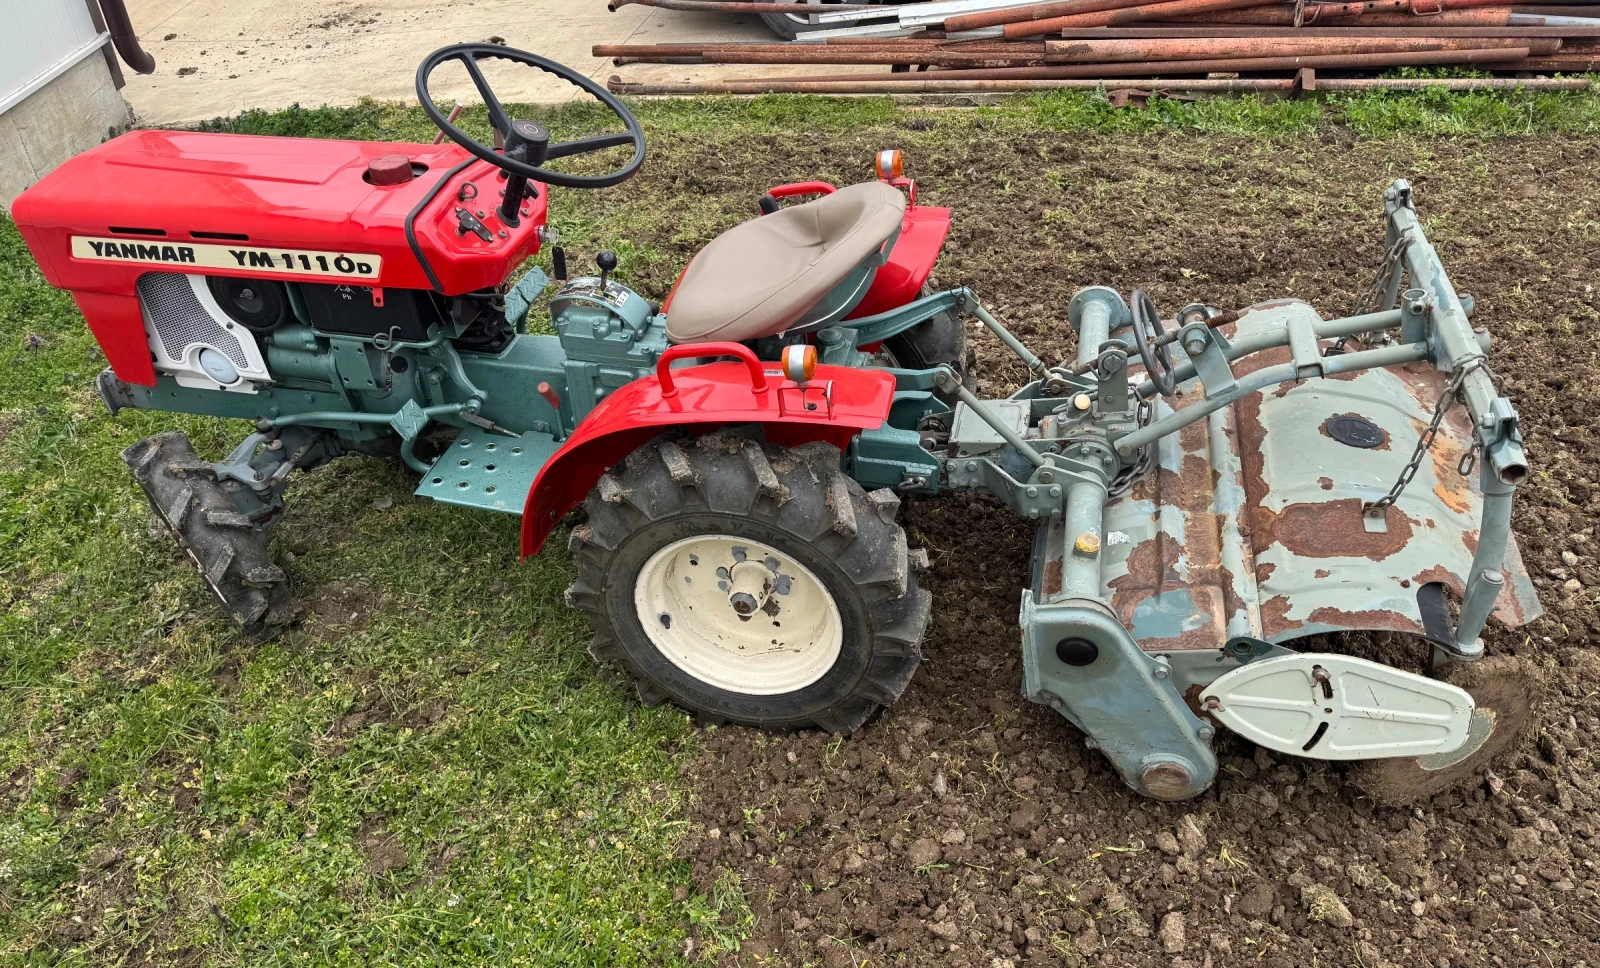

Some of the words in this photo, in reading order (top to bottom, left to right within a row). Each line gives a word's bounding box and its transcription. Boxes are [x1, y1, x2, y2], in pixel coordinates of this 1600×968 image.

[87, 240, 195, 263] YANMAR
[229, 249, 275, 268] YM
[341, 293, 352, 301] Pb
